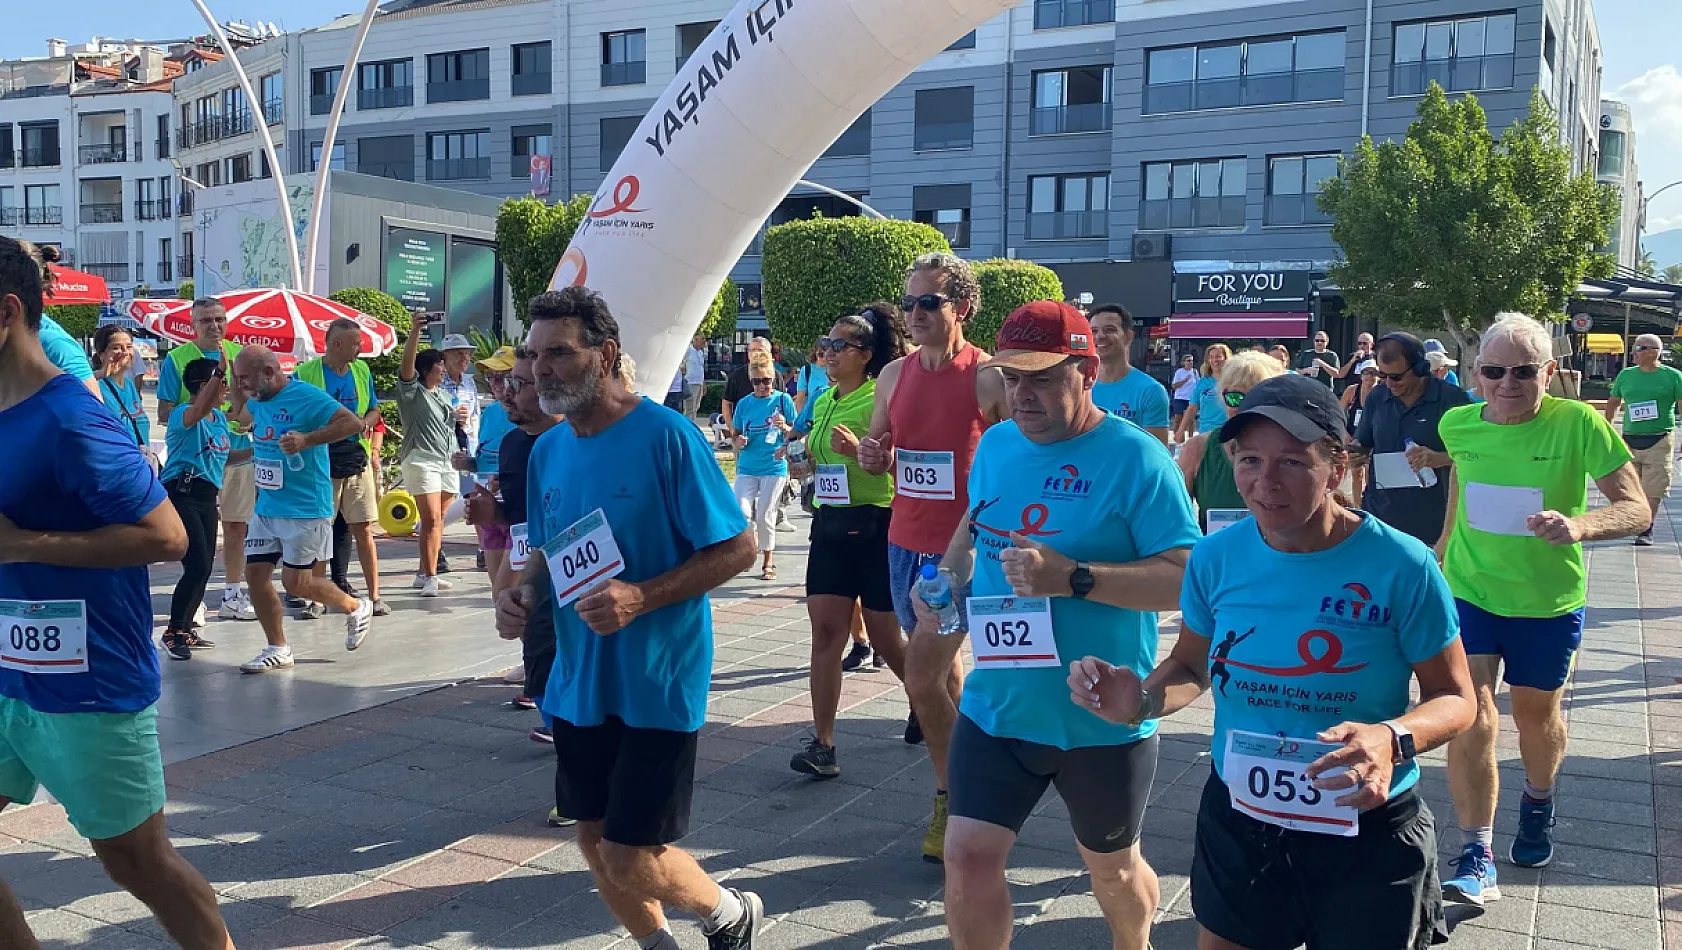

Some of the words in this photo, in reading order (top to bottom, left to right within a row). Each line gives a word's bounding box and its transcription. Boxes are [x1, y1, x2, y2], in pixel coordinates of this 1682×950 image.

[646, 32, 741, 157] YAŞAM
[1198, 274, 1237, 293] FOR
[1241, 273, 1284, 293] YOU
[1216, 293, 1262, 310] Boutique
[256, 467, 274, 481] 039
[904, 466, 937, 486] 063
[820, 477, 839, 492] 035
[1043, 477, 1093, 494] FETAV
[518, 539, 533, 556] 08
[562, 540, 600, 579] 040
[10, 624, 61, 651] 088
[985, 620, 1032, 648] 052
[1234, 680, 1279, 694] YAŞAM
[1247, 696, 1283, 708] RACE
[1285, 701, 1311, 713] FOR
[1248, 766, 1322, 806] 053
